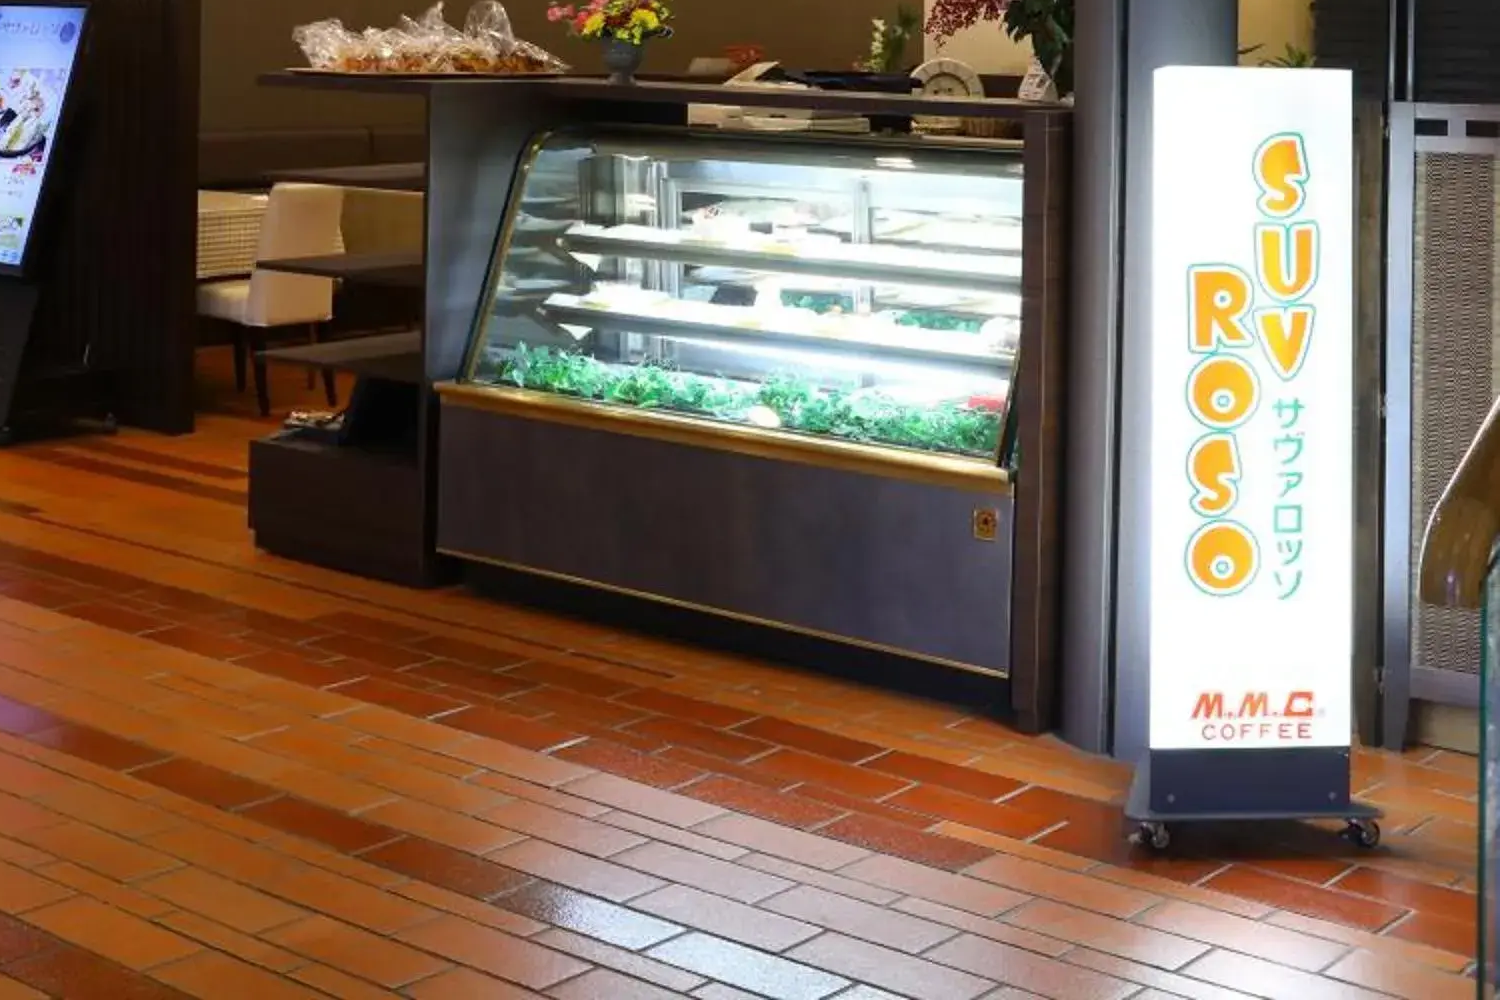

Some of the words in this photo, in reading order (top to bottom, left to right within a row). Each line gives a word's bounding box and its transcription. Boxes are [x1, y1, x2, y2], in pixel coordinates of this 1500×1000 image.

[1252, 132, 1320, 382] SUV
[1184, 263, 1261, 597] ROSO
[1272, 397, 1306, 601] サヴァロッソ
[1200, 722, 1313, 741] COFFEE
